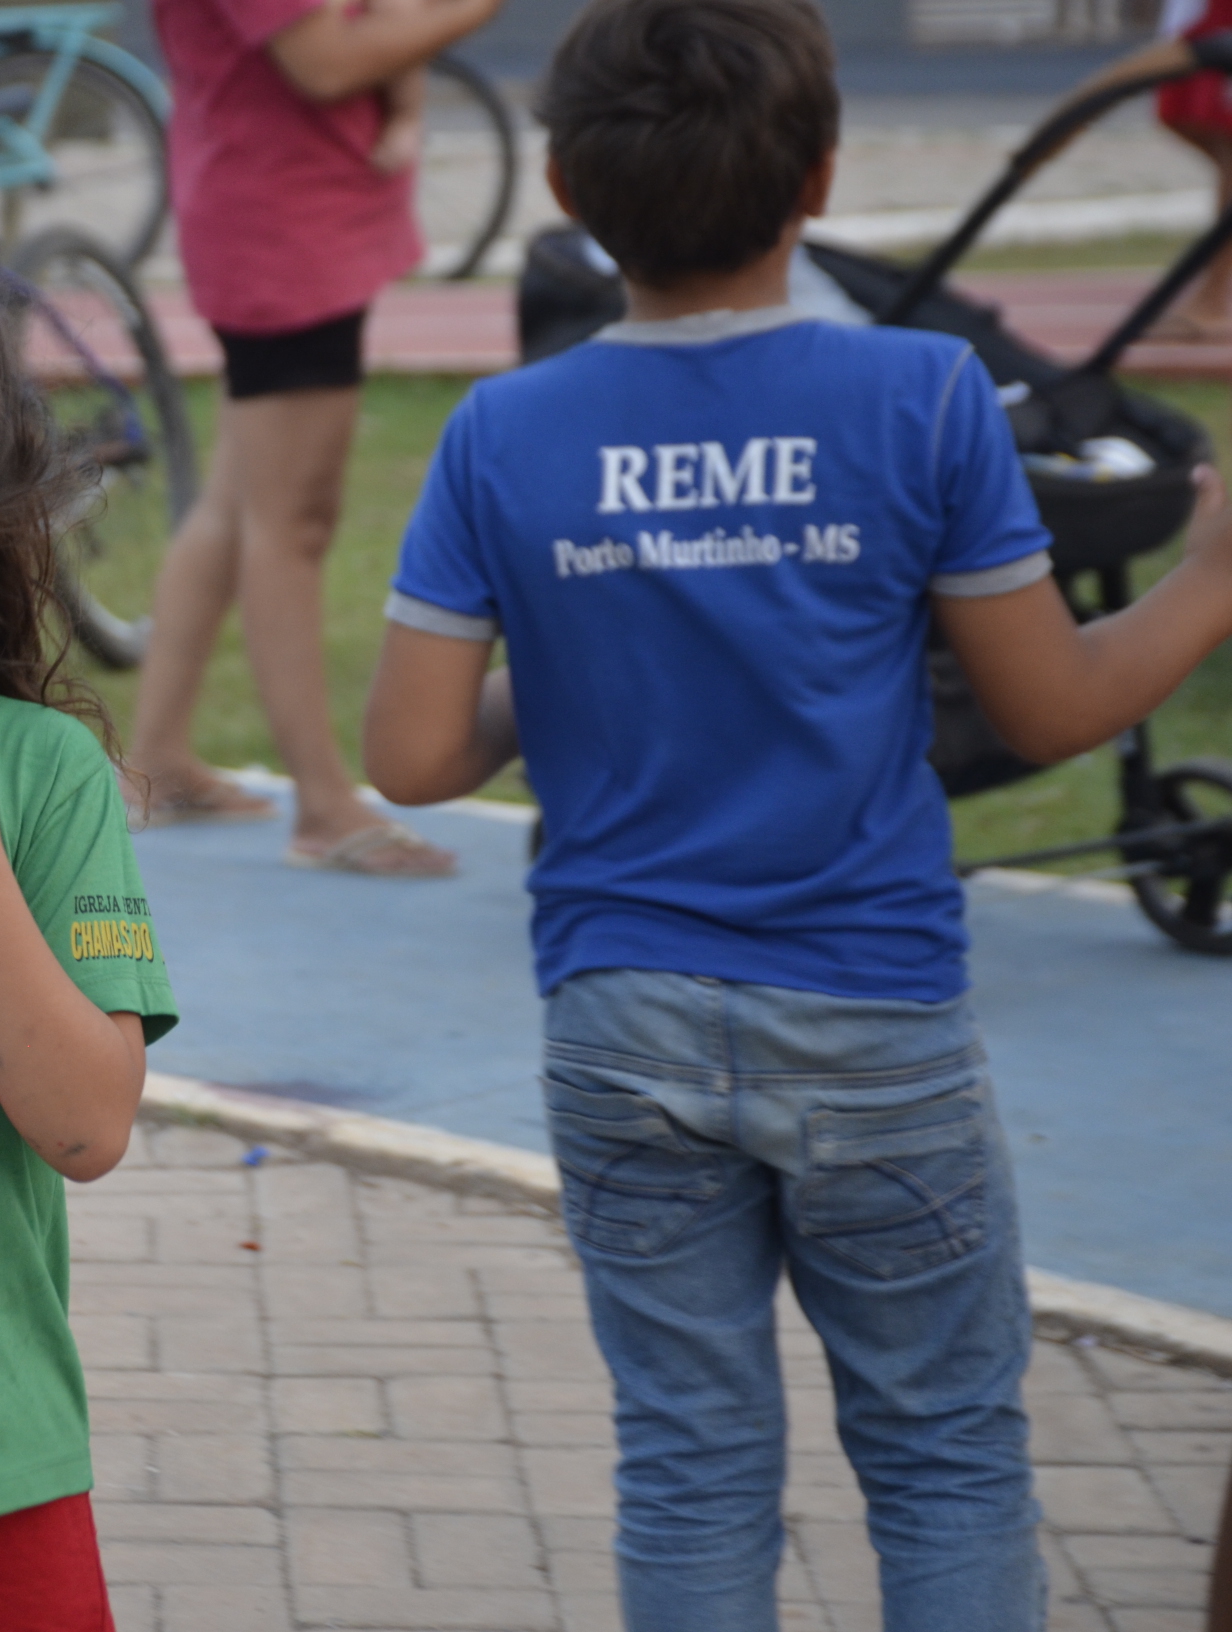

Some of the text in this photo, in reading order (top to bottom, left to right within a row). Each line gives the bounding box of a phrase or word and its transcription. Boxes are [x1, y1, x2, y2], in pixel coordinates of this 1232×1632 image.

[597, 437, 817, 514] REME
[553, 538, 635, 579] Porto
[636, 525, 782, 570] Murtinho
[801, 523, 862, 565] MS
[73, 895, 122, 915] IGREJA
[70, 920, 155, 963] CHAMAS DO
